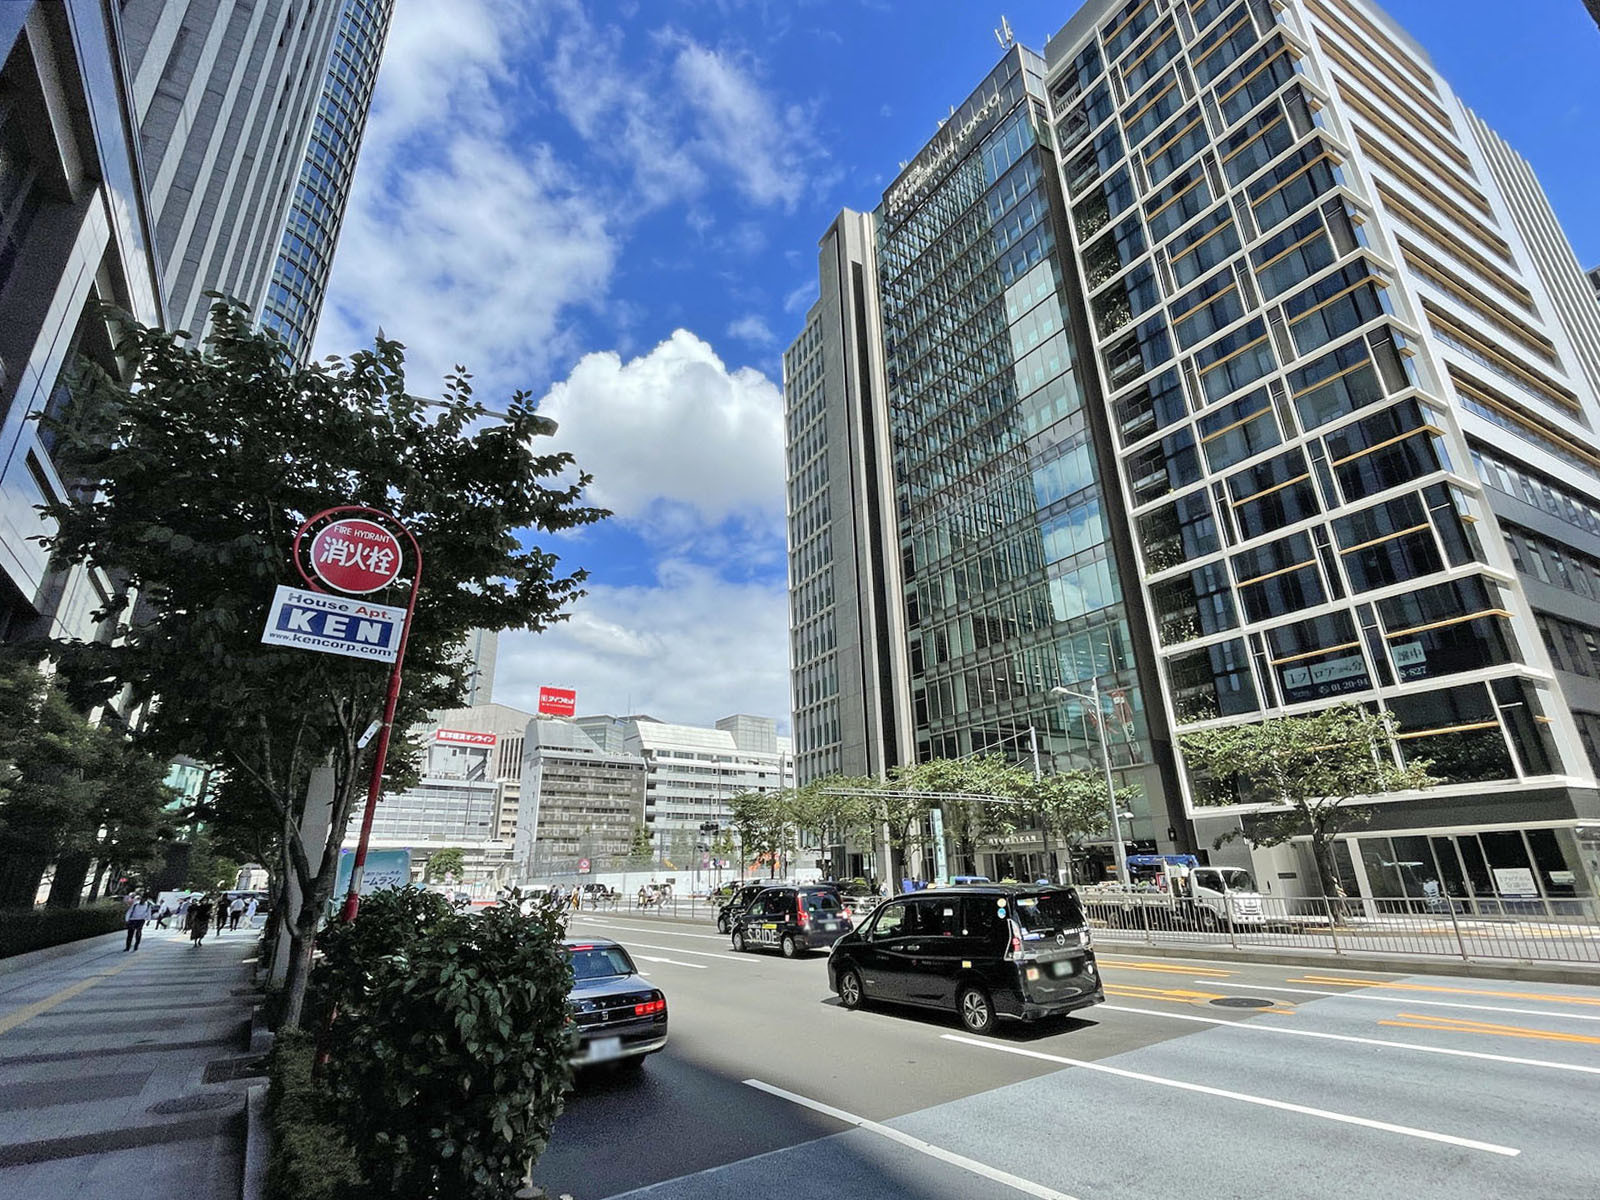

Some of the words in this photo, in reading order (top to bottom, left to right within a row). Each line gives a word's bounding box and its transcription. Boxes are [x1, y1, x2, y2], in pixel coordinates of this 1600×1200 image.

[956, 92, 1001, 141] TOKYO
[333, 525, 352, 536] FIRE
[354, 529, 391, 544] HYDRANT
[319, 535, 395, 576] 消火栓
[288, 592, 349, 612] House
[355, 606, 392, 620] Apt.
[287, 607, 383, 644] KEN
[269, 631, 392, 657] www.kencorp.com
